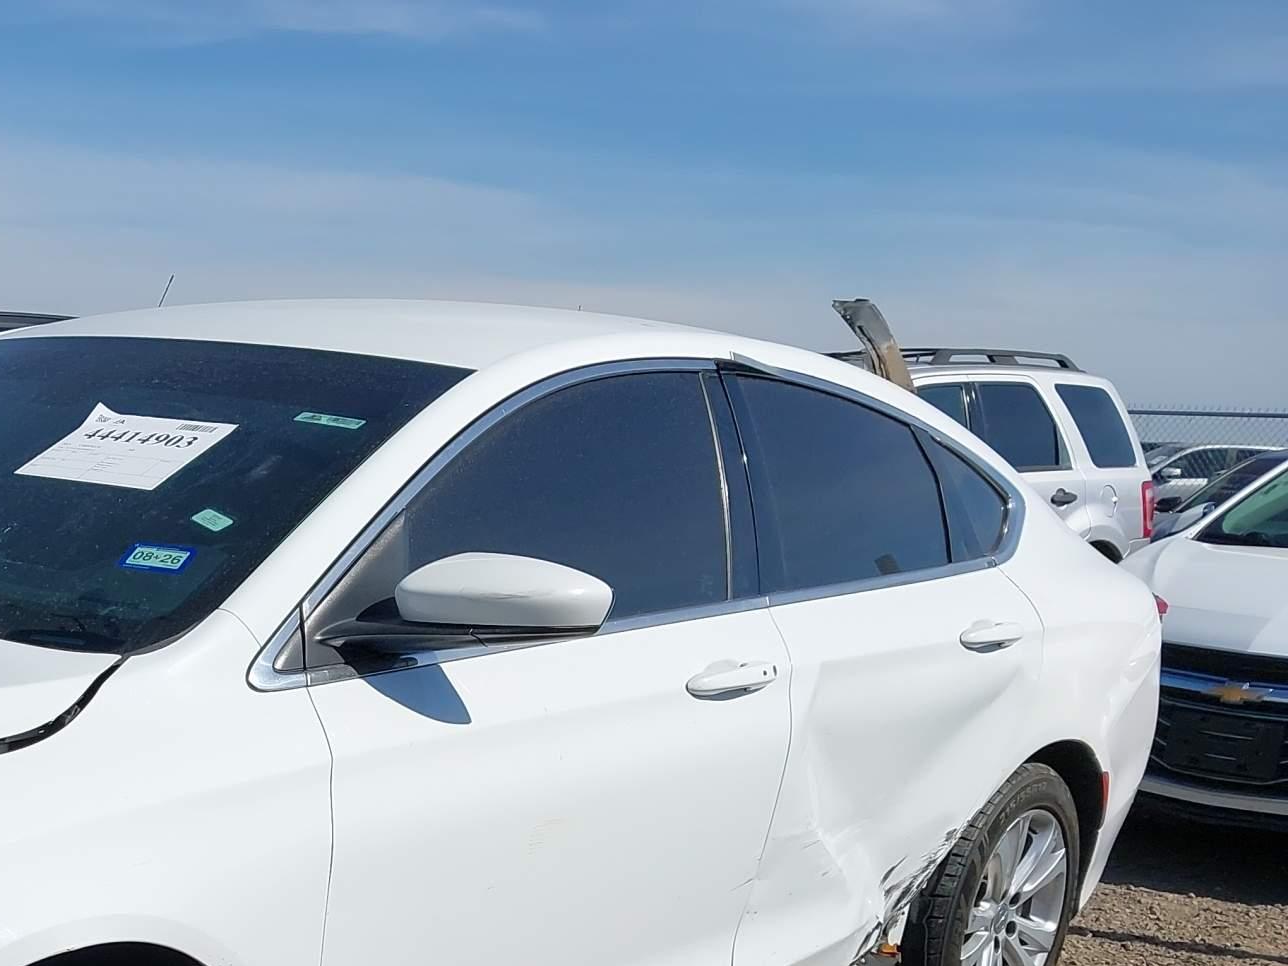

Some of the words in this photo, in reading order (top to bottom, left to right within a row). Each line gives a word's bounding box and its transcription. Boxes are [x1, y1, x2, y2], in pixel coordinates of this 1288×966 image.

[84, 428, 199, 449] 44414903
[132, 550, 153, 562] 08
[160, 553, 183, 565] 26
